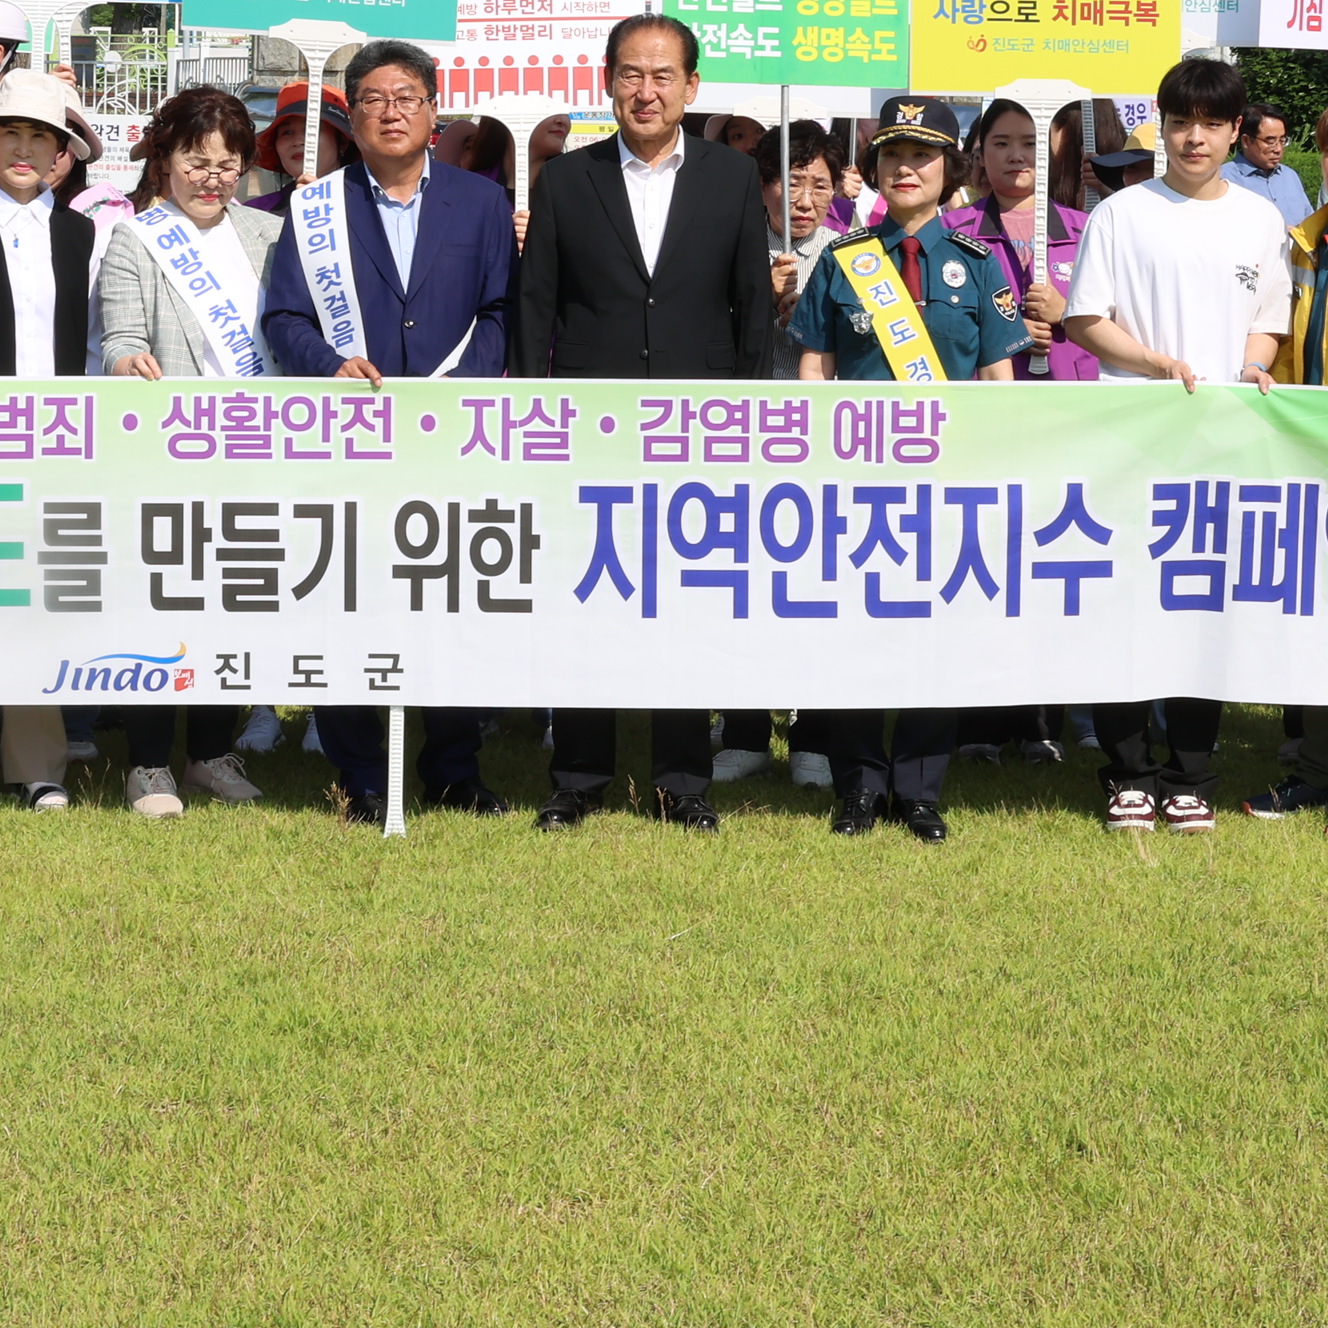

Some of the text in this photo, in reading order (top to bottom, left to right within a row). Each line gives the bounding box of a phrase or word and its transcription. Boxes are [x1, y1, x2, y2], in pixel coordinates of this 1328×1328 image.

[561, 0, 611, 14] 시작하면
[792, 26, 898, 63] 생명속도
[992, 37, 1130, 54] 진도군 치매안심센터
[156, 223, 222, 299] 예방의
[301, 179, 356, 350] 예방의 첫걸음
[165, 393, 394, 461] 생활안전
[459, 395, 577, 462] 자살
[637, 397, 809, 464] 감염병
[832, 397, 947, 465] 예방
[140, 498, 358, 615] 만들기
[392, 497, 541, 615] 위한
[573, 482, 1114, 621] 지역안전지수
